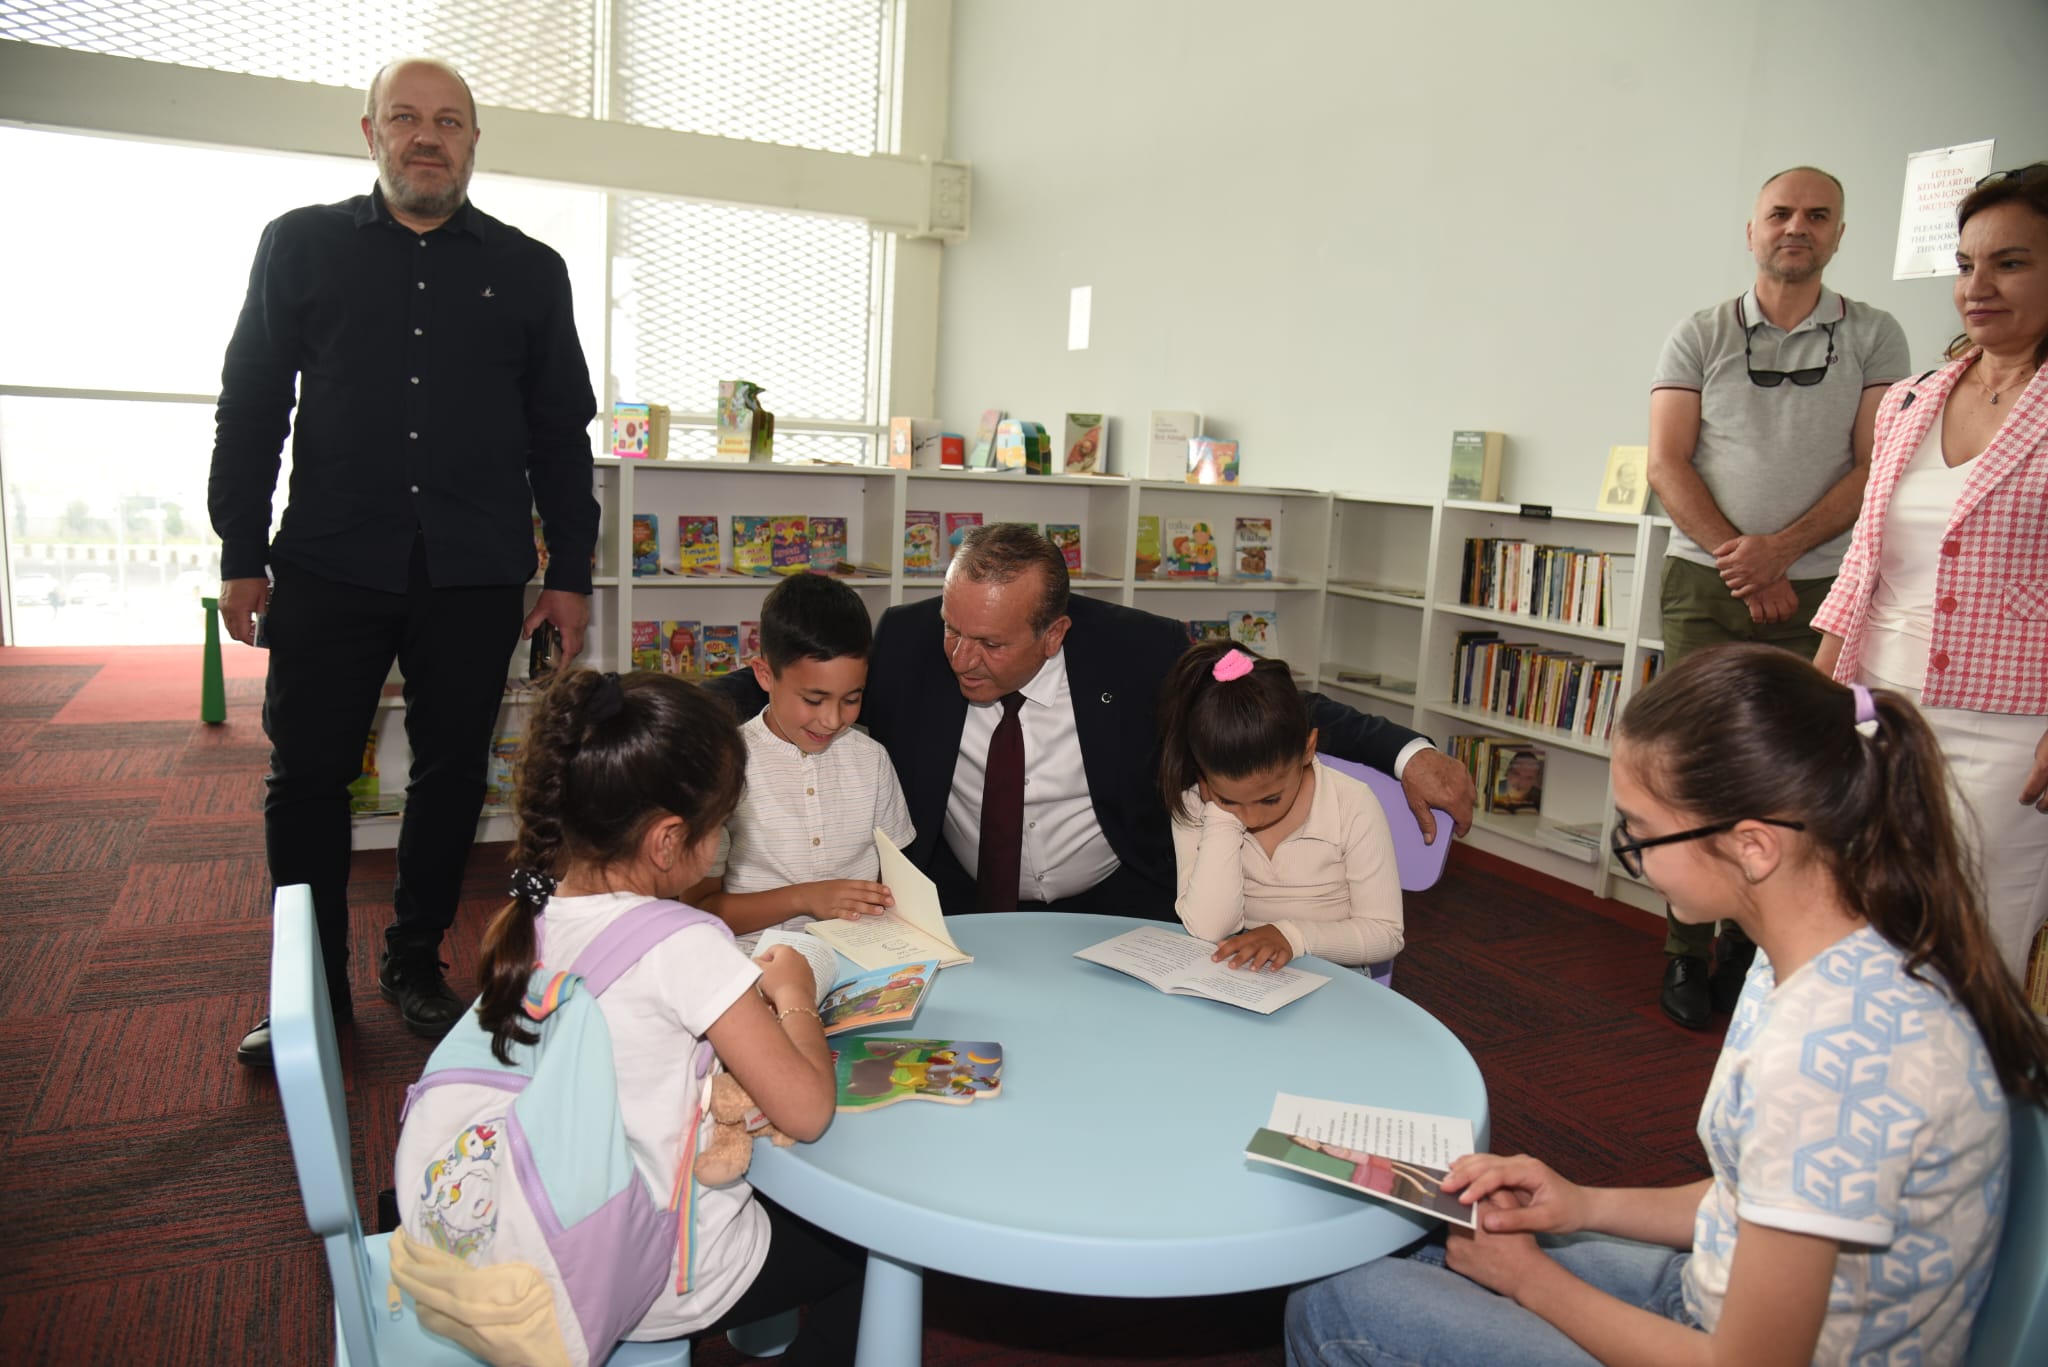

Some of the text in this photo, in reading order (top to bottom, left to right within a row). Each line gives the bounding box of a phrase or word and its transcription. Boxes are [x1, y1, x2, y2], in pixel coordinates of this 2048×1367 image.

[1914, 223, 1941, 232] PLEASE
[1911, 234, 1926, 242] THE
[1916, 243, 1935, 252] THIS
